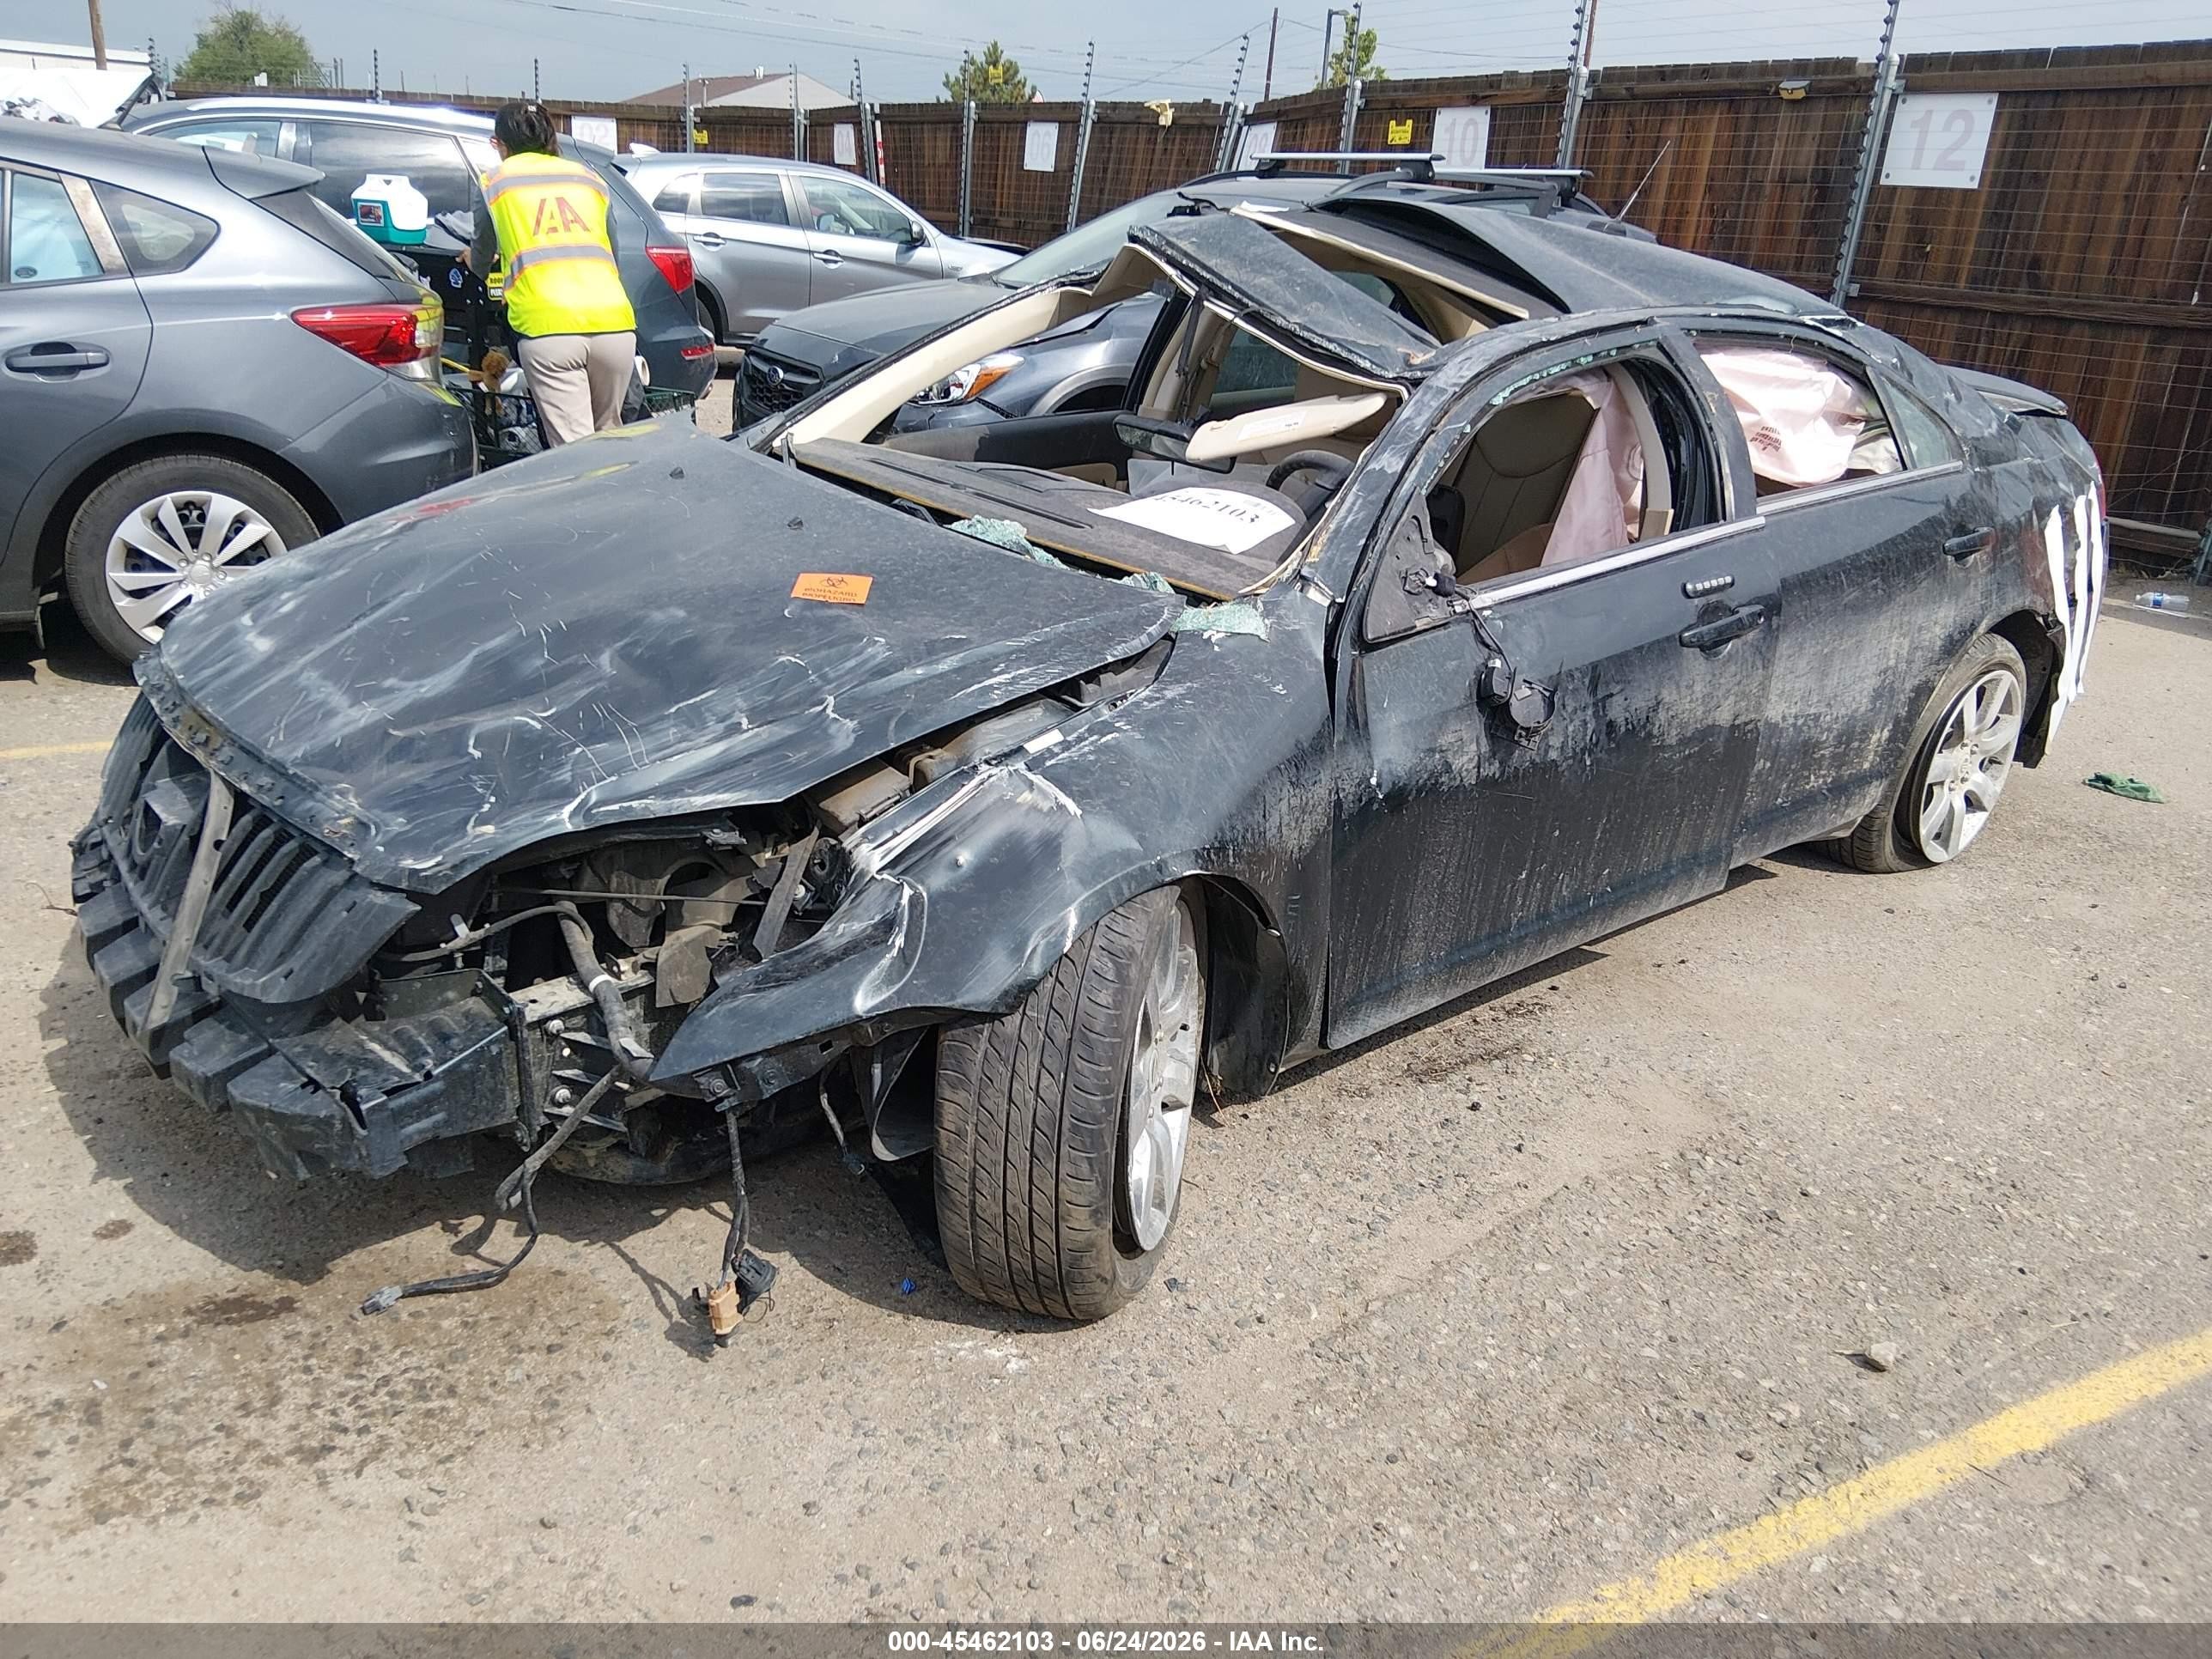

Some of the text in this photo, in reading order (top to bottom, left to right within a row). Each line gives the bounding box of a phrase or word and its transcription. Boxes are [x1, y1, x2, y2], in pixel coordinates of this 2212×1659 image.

[837, 130, 854, 157] 04
[1444, 118, 1480, 166] 10
[1910, 108, 1975, 171] 12
